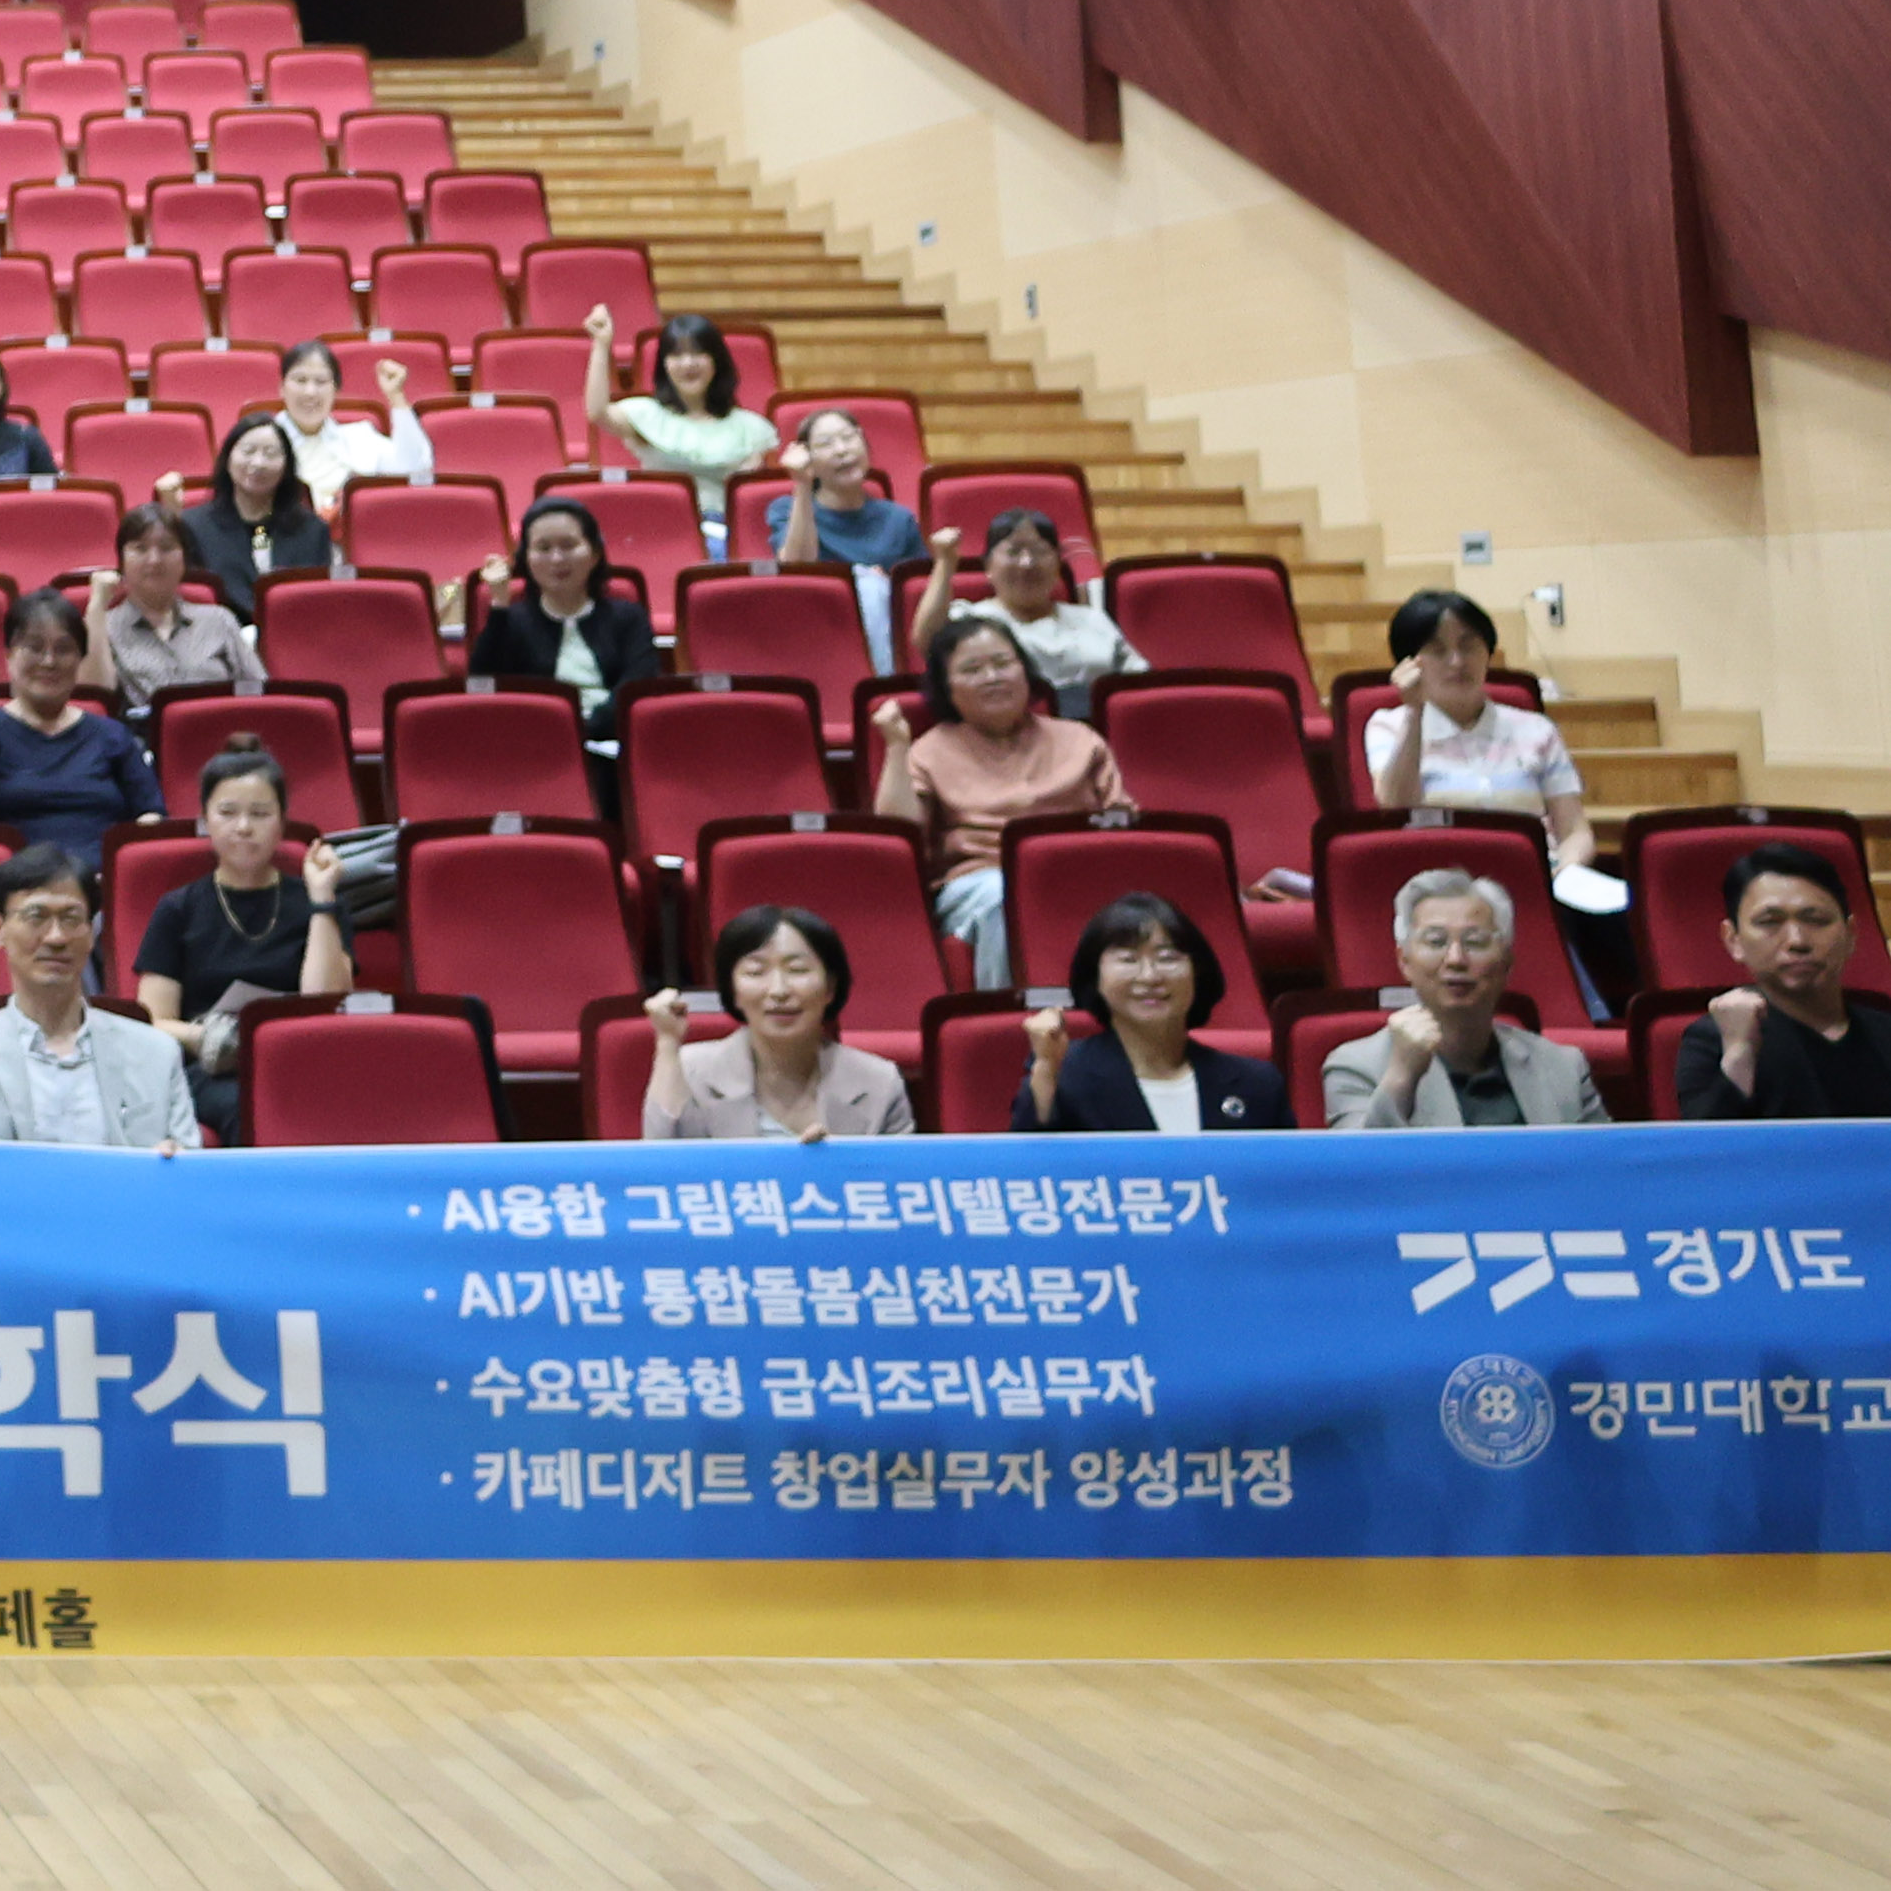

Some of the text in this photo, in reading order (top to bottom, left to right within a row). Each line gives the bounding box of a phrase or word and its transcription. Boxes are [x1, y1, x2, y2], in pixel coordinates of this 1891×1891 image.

[441, 1174, 1229, 1239] AI융합 그림책스토리텔링전문가
[1646, 1227, 1866, 1297] 경기도
[458, 1264, 1140, 1327] AI기반 통합돌봄실천전문가
[469, 1355, 1157, 1419] 수요맞춤형 급식조리실무자
[1570, 1378, 1891, 1438] 경민대학교
[473, 1447, 1293, 1511] 카페디저트 창업실무자 양성과정
